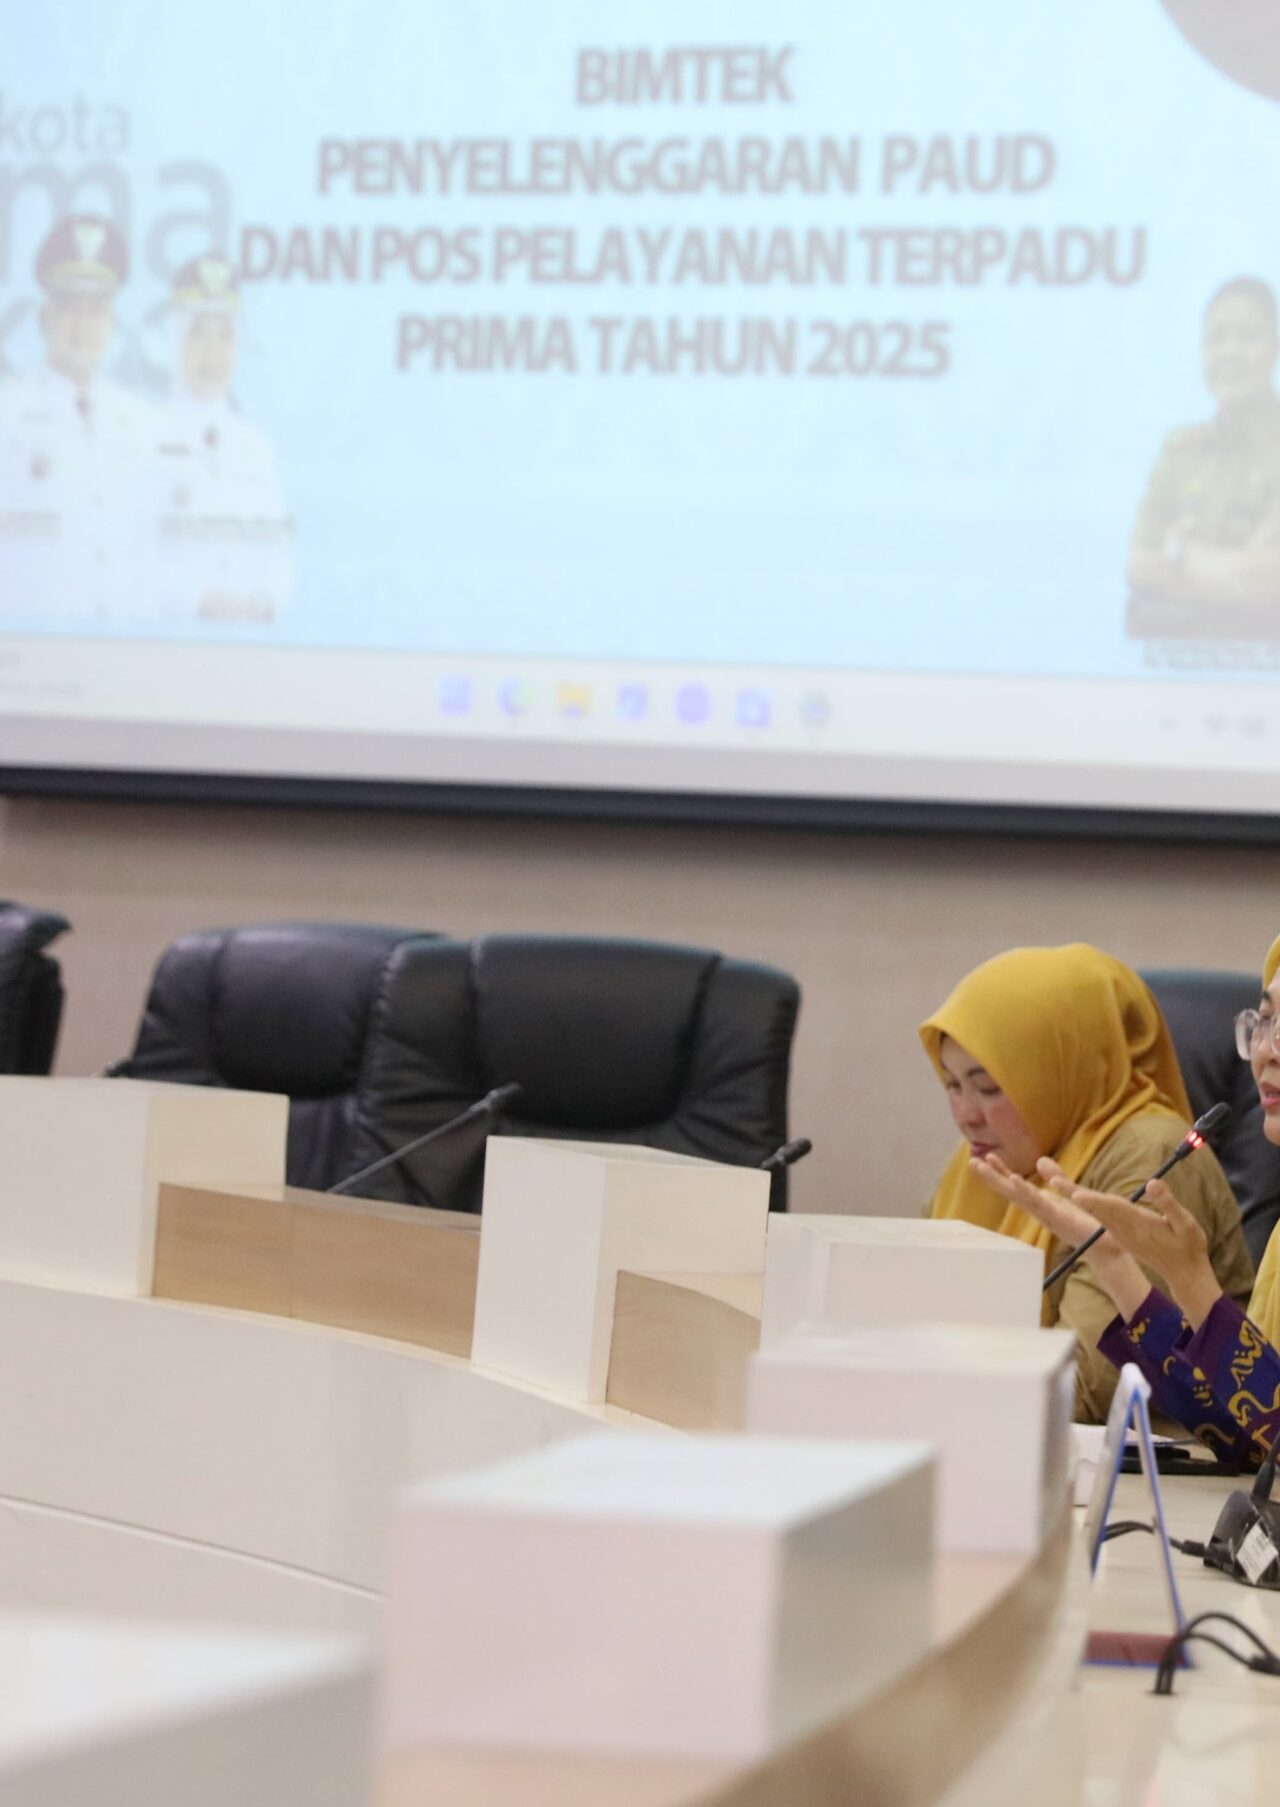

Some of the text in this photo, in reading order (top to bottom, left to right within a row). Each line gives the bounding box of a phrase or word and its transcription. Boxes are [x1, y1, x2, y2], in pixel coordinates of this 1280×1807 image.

[574, 44, 796, 106] BIMTEK
[317, 133, 1058, 195] PENYELENGGARAN PAUD
[241, 226, 1147, 287] DAN POS PELAYANAN TERPADU
[395, 315, 951, 379] PRIMA TAHUN 2025
